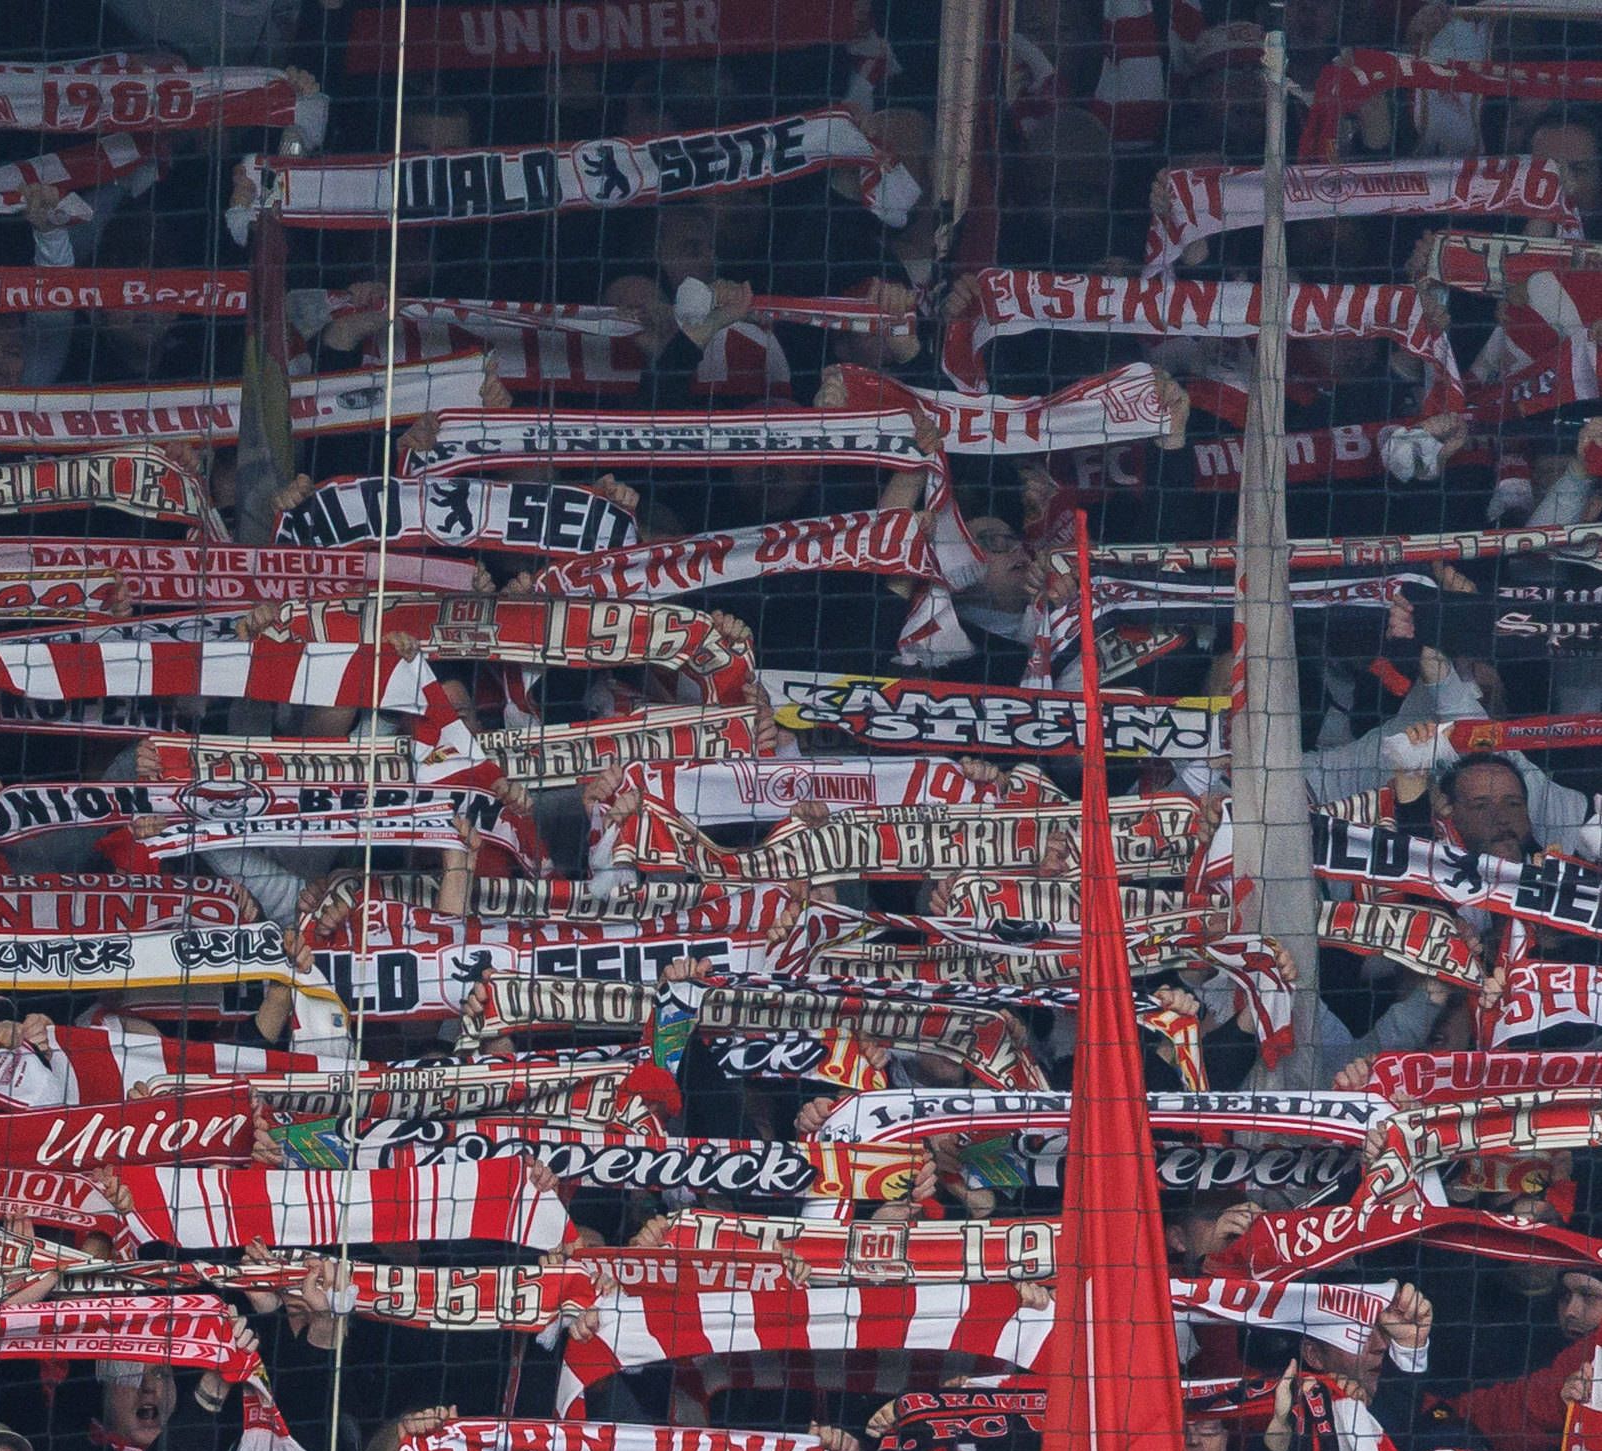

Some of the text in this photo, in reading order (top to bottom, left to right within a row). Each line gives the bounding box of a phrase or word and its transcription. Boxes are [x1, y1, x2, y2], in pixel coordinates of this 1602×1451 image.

[460, 0, 721, 58] UNIONER
[33, 545, 366, 579] DAMALS WIE HEUTE
[814, 773, 876, 804] UNION
[111, 873, 163, 893] DER
[378, 1068, 446, 1092] JAHRE
[36, 1108, 246, 1169] Union
[861, 1239, 895, 1260] 60
[36, 1312, 231, 1342] UNION
[6, 1336, 70, 1356] ALTEN
[74, 1336, 189, 1356] FOERSTEREI
